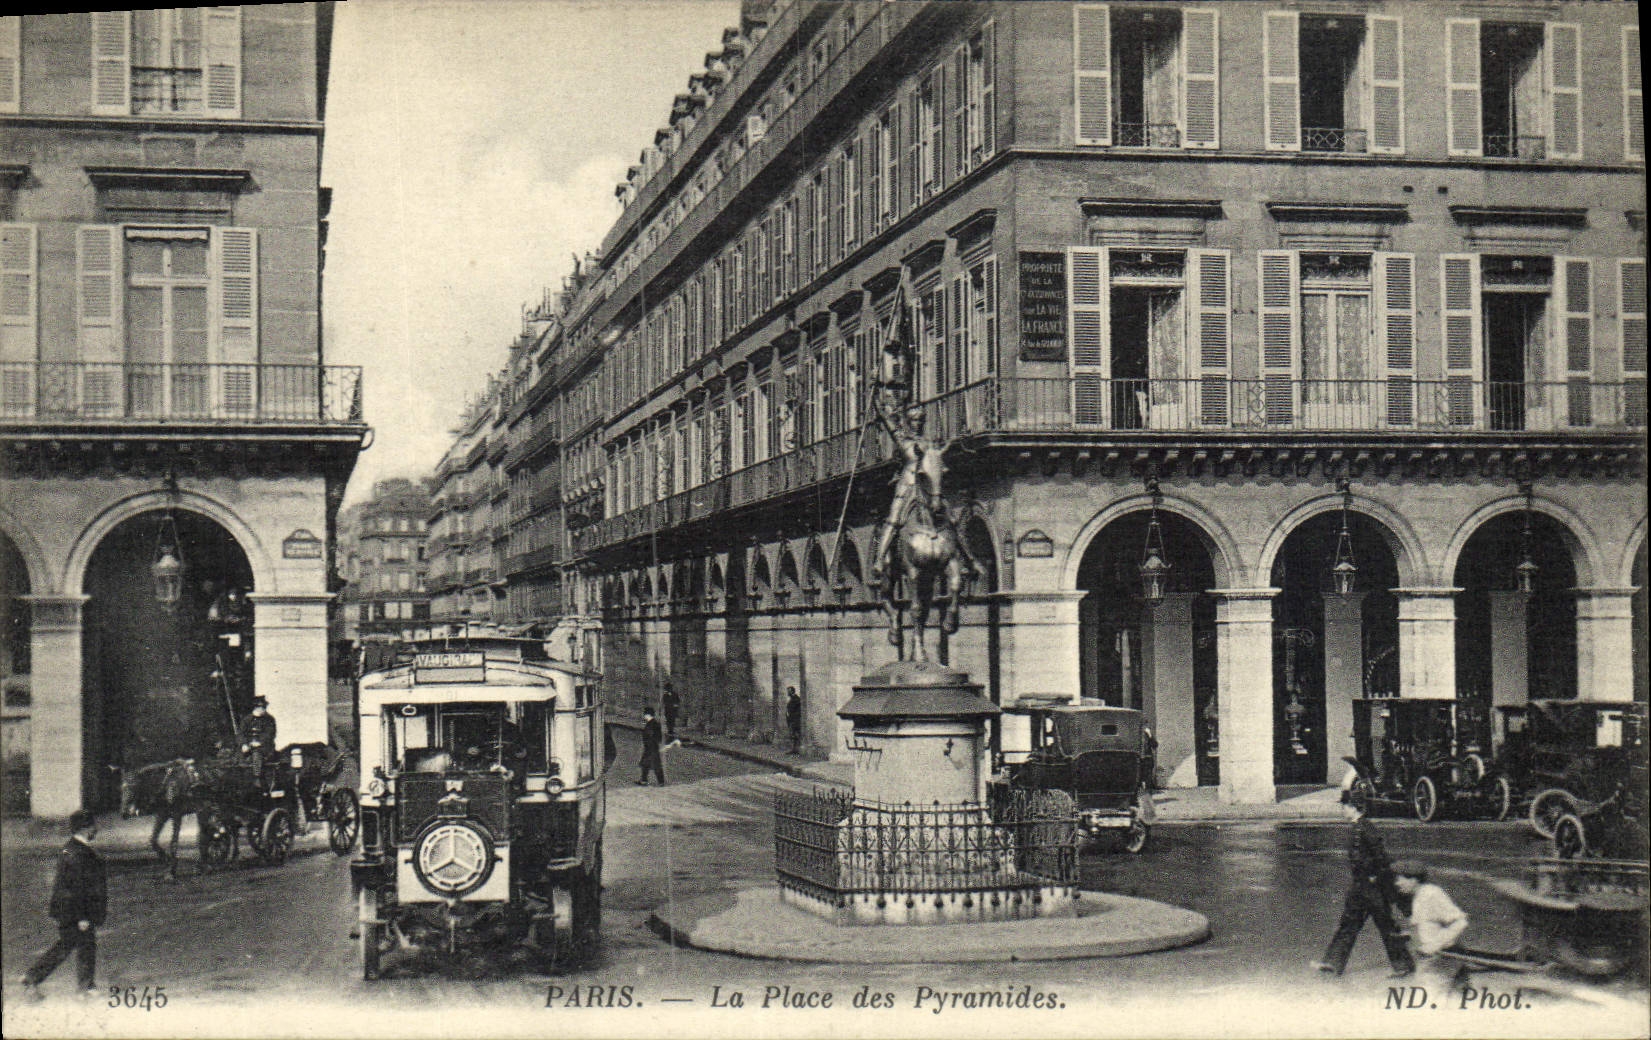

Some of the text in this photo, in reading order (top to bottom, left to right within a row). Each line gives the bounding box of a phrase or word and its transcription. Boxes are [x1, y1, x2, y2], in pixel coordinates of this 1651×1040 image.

[1043, 278, 1053, 286] LA
[1036, 303, 1047, 316] LA
[1021, 319, 1032, 334] LA
